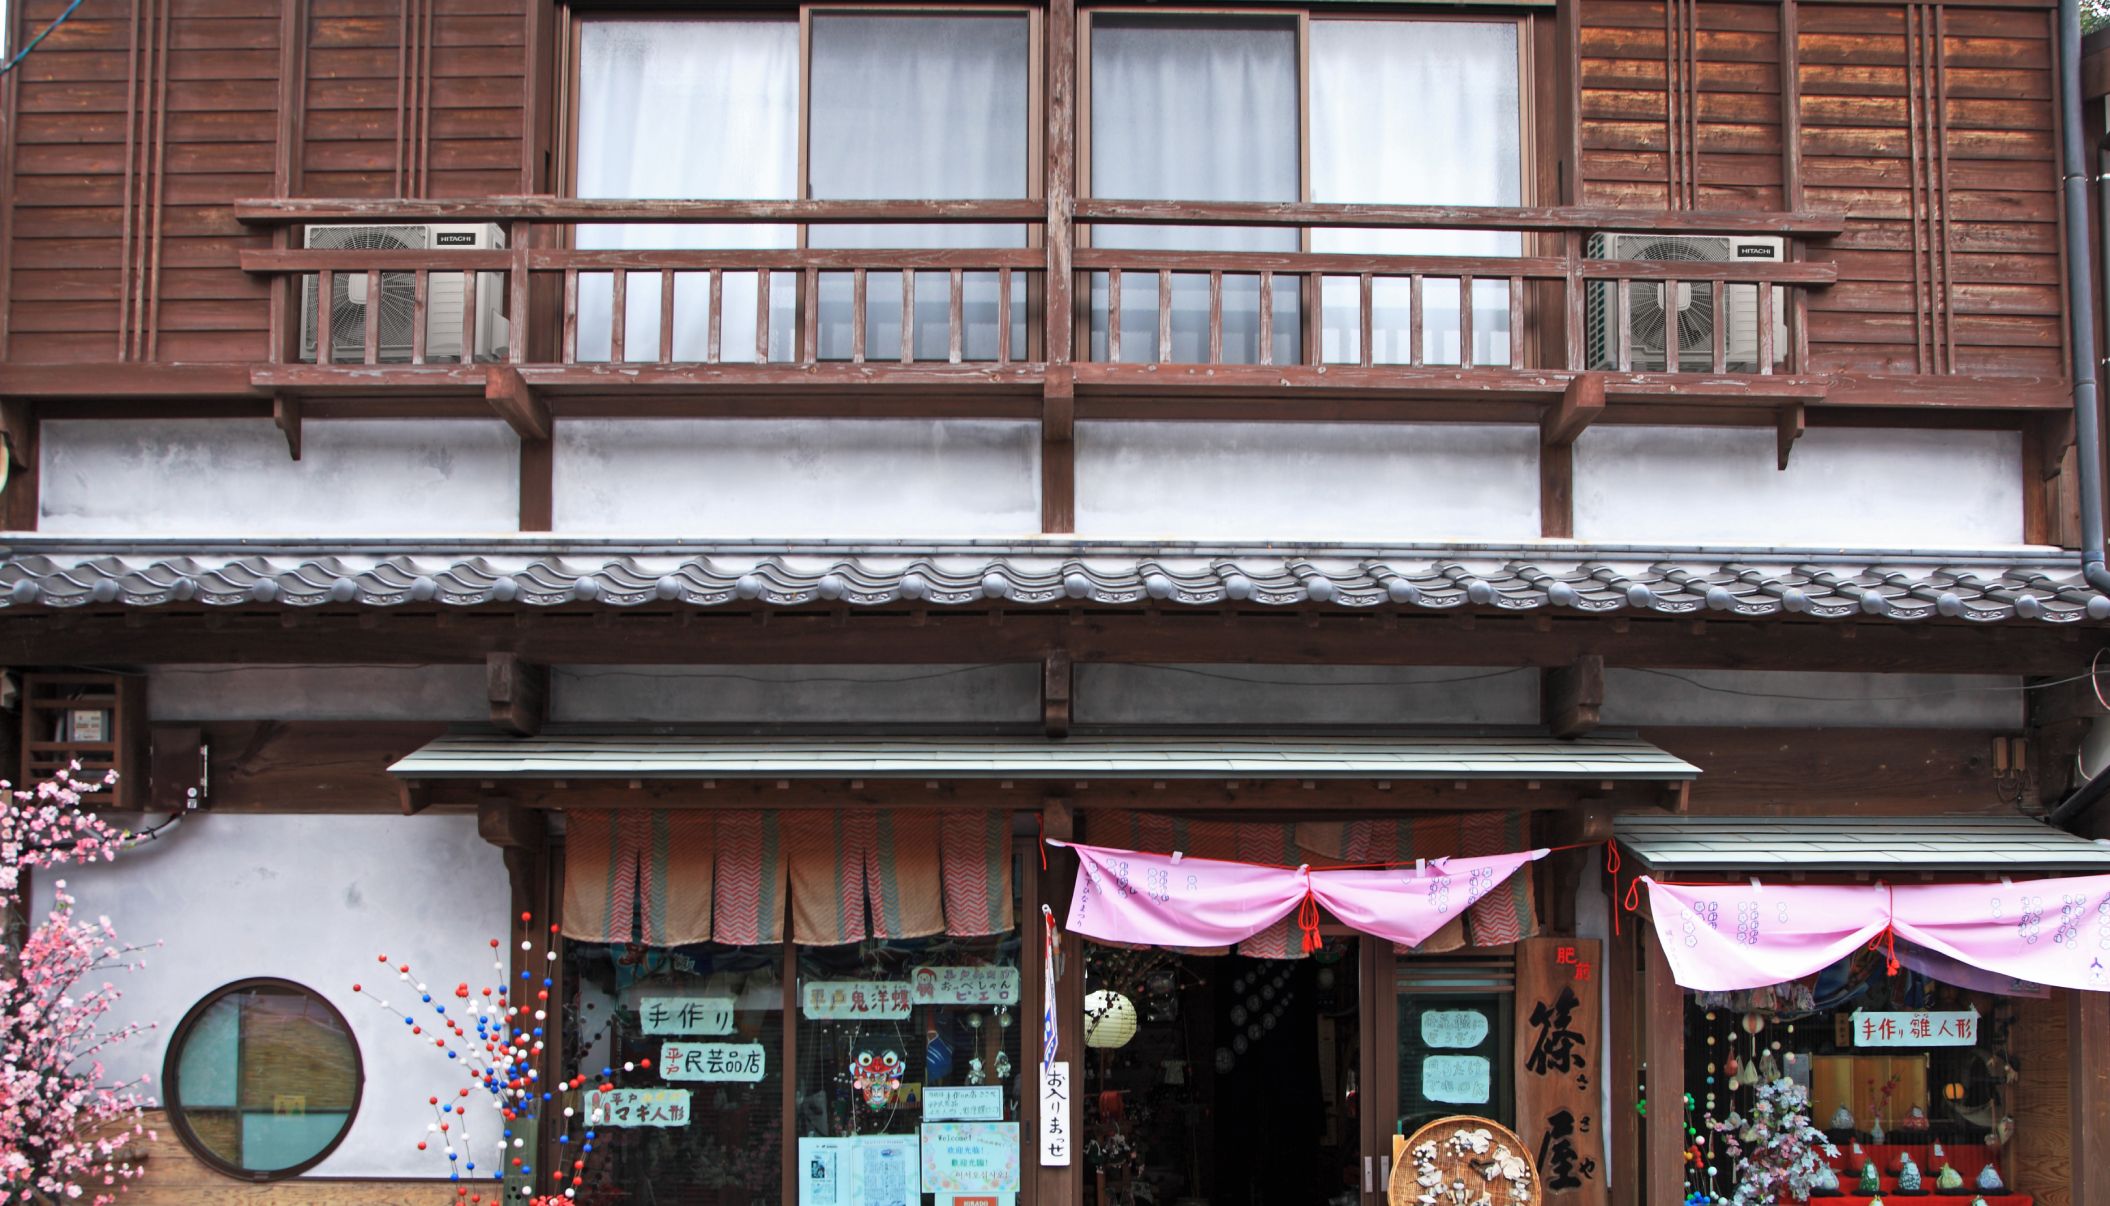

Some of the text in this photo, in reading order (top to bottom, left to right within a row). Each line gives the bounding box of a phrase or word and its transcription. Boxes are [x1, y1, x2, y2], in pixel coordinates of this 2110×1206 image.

[1557, 947, 1591, 981] 肥前
[649, 1002, 729, 1031] 手作り
[1862, 1017, 1972, 1041] 手作り雛人形
[665, 1047, 684, 1075] 平戸
[685, 1048, 761, 1074] 民芸品店
[1044, 1070, 1067, 1157] お入りまっせ
